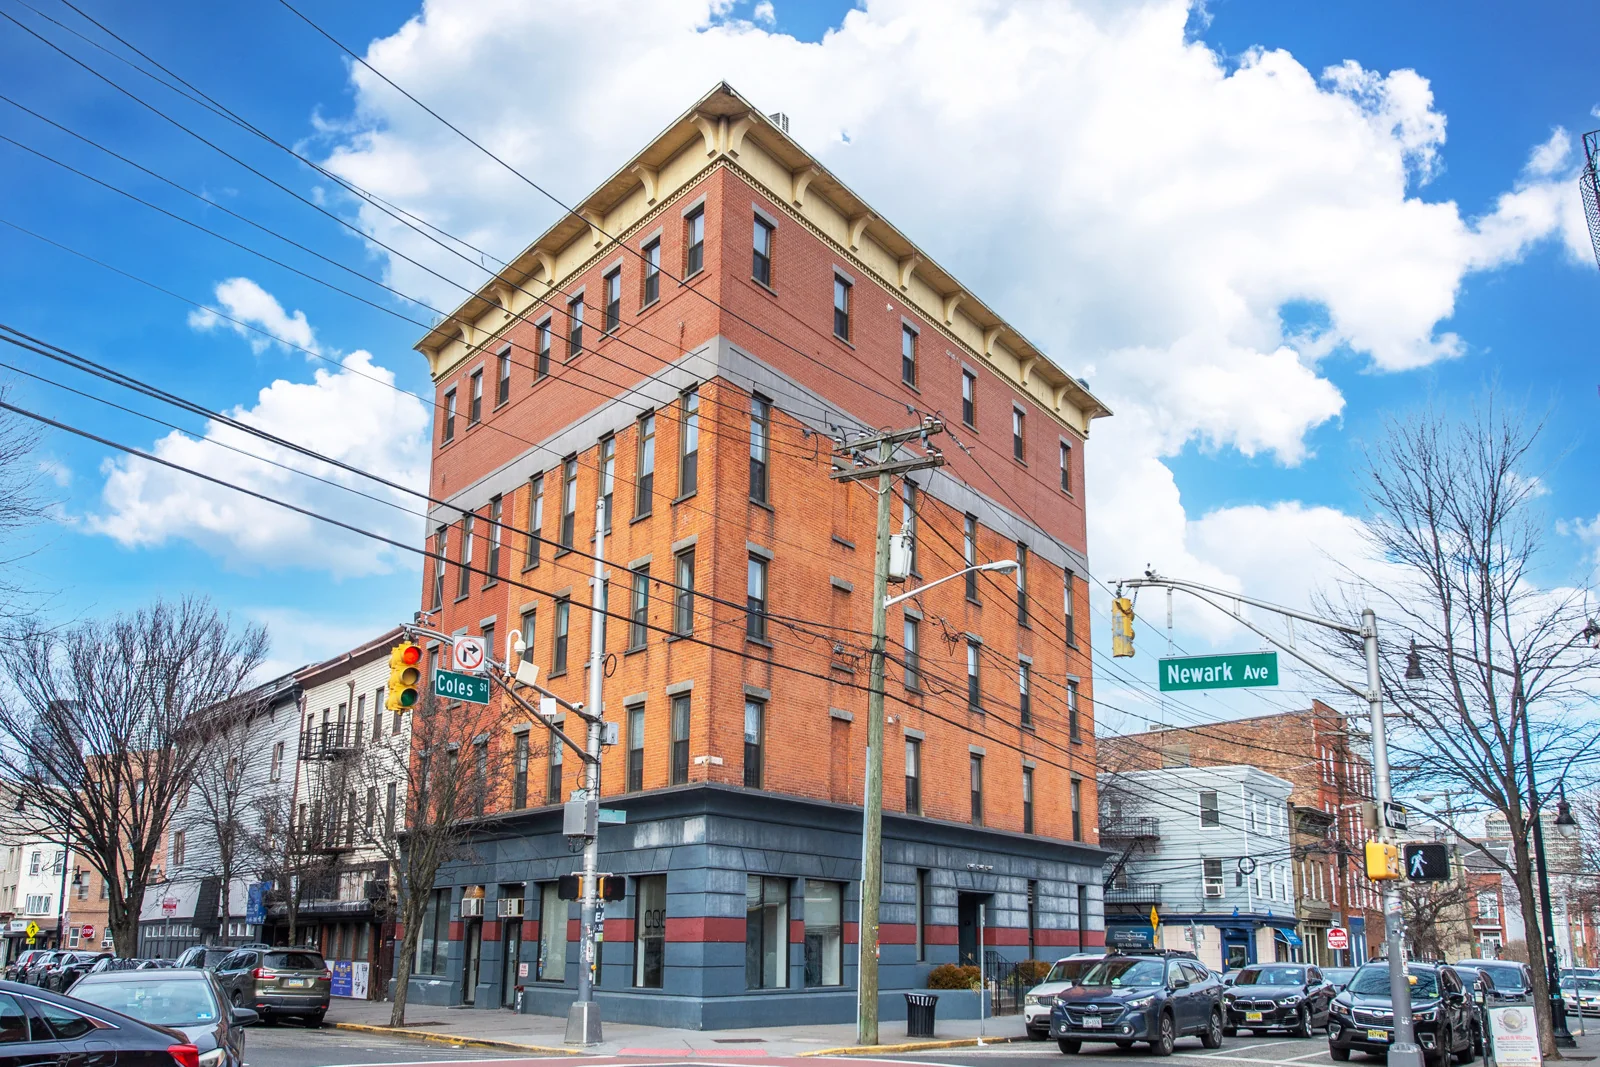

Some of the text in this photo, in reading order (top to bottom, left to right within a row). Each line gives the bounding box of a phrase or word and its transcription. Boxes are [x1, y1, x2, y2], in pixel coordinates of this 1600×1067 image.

[1168, 662, 1268, 684] Newark Ave
[438, 674, 487, 697] Coles St
